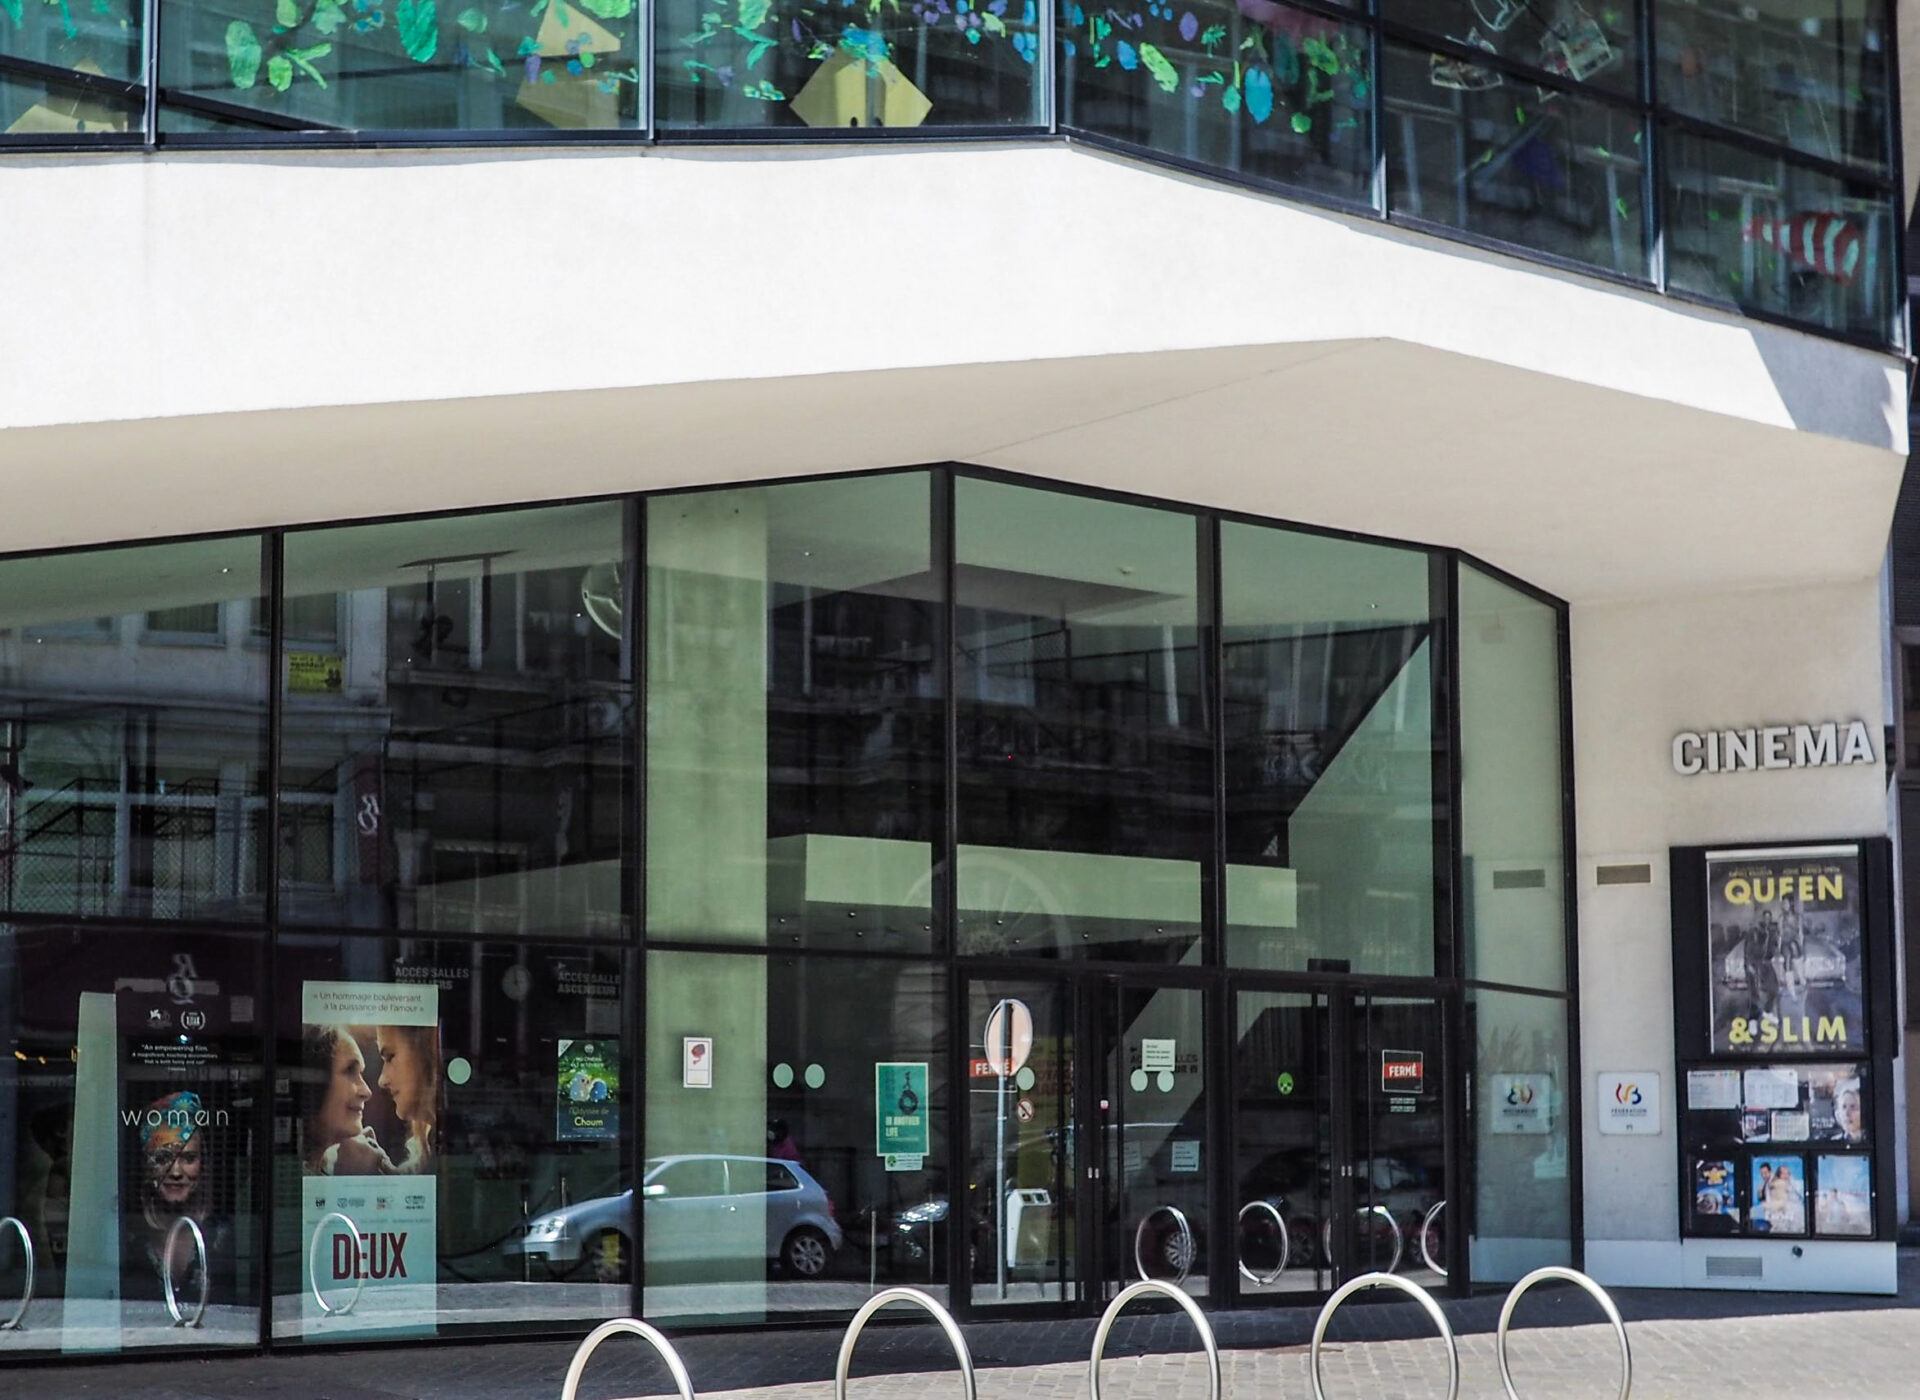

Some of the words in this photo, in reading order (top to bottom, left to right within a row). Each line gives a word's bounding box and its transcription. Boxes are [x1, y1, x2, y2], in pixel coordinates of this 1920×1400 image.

[1672, 721, 1875, 775] CINEMA
[431, 968, 469, 979] SALLES
[591, 973, 620, 984] SALLE
[332, 992, 372, 1002] hommage
[1760, 1015, 1847, 1043] SLIM
[1389, 1062, 1417, 1078] FERMÉ
[574, 1116, 603, 1126] Choum
[333, 1232, 408, 1280] DEUX
